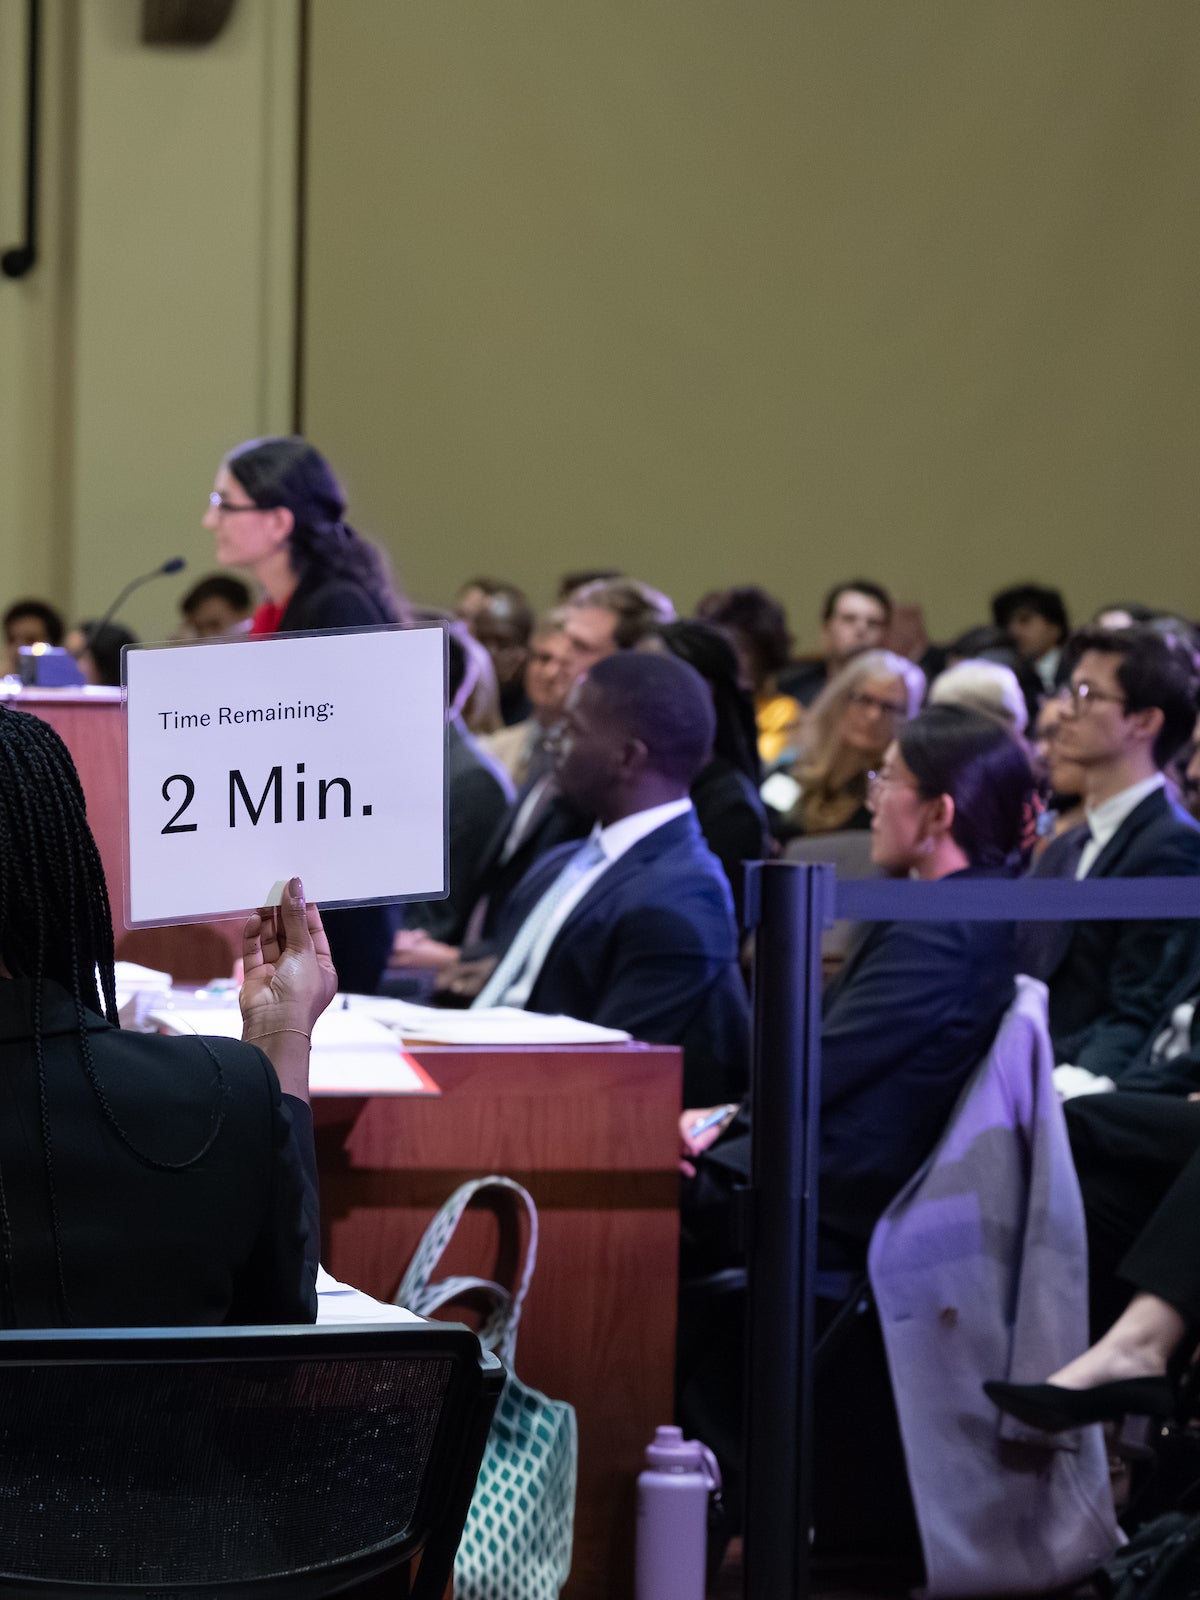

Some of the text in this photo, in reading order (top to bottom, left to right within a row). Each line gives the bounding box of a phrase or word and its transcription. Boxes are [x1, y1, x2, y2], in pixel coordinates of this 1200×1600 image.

[158, 700, 335, 730] Time Remaining:
[160, 762, 373, 835] 2 Min.
